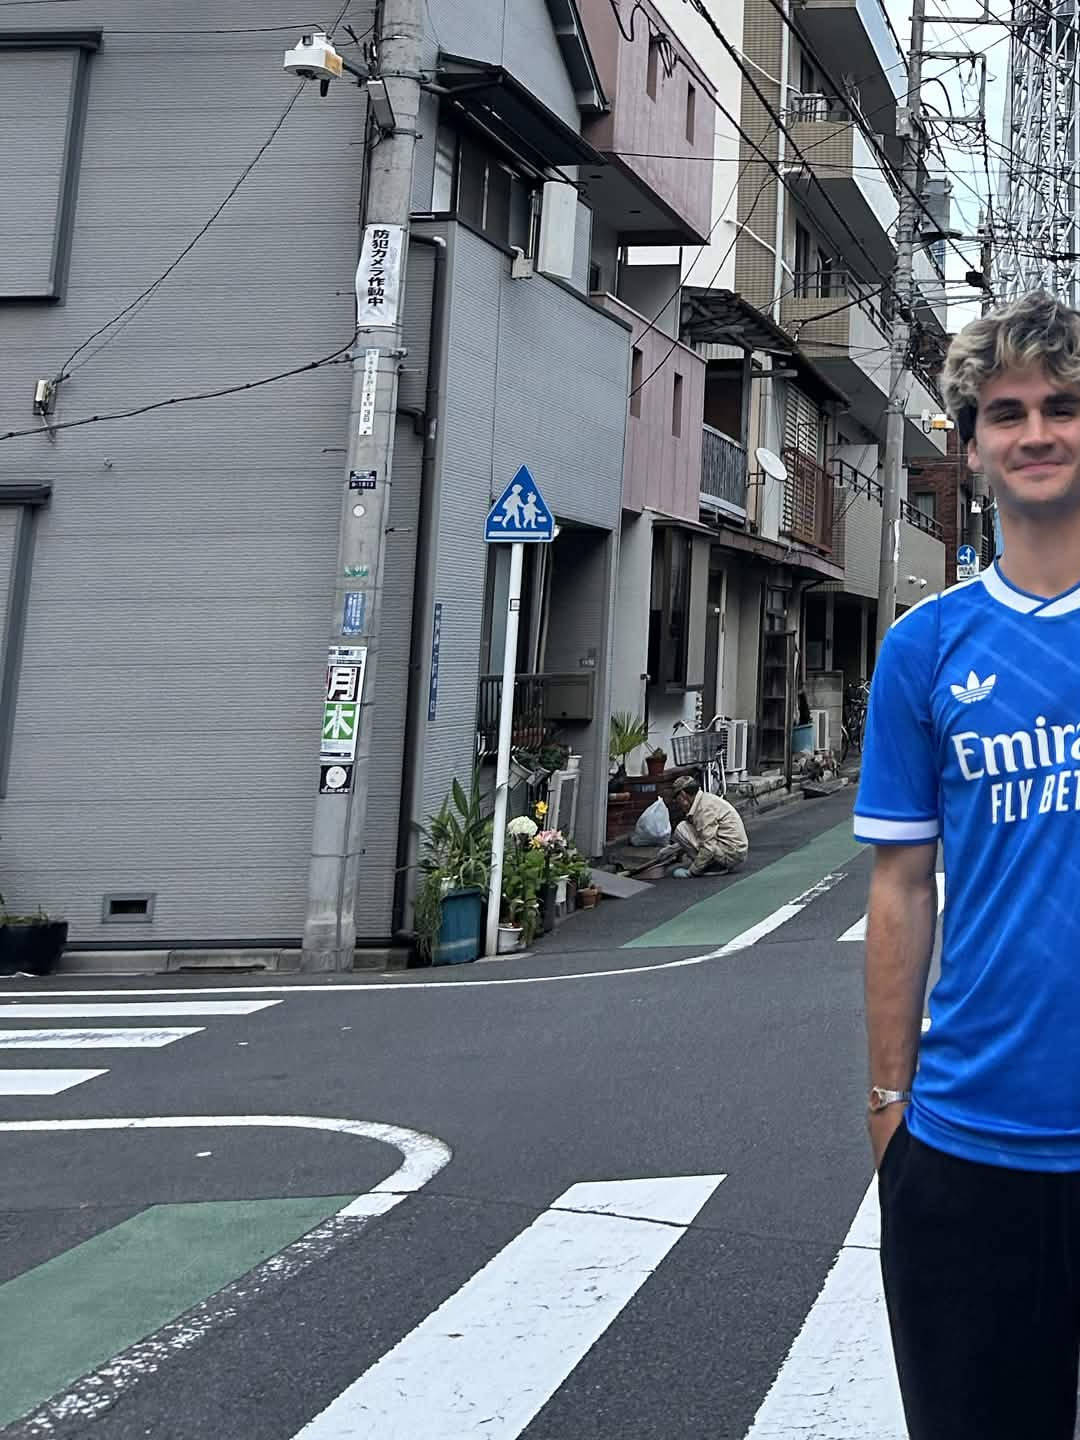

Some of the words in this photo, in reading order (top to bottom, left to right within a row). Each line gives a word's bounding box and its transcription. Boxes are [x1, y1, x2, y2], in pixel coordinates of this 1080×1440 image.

[367, 229, 390, 307] 防犯カメラ作動中
[328, 666, 358, 701] 月
[324, 704, 354, 739] 木
[991, 778, 1033, 824] FLY
